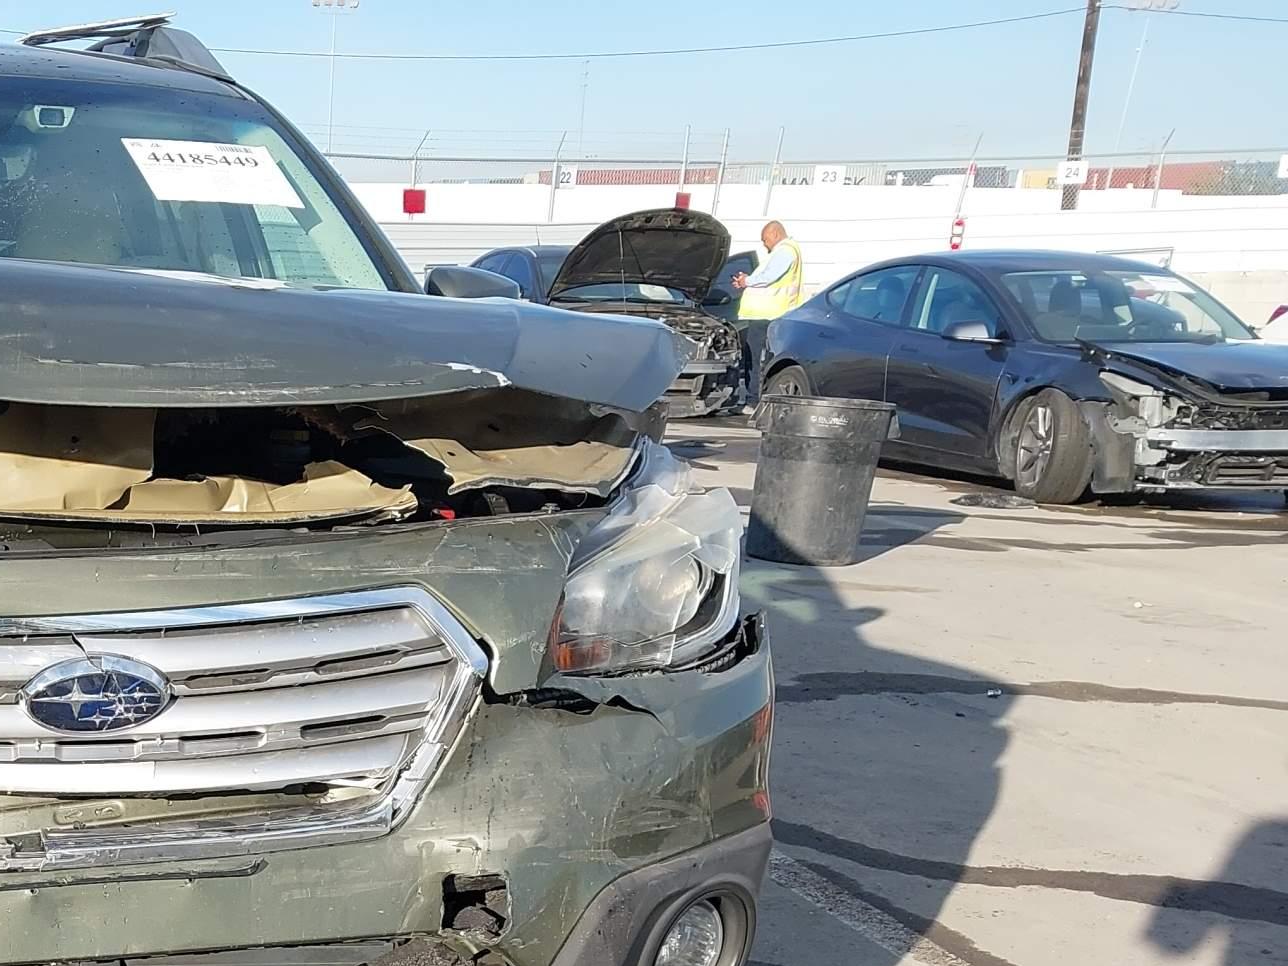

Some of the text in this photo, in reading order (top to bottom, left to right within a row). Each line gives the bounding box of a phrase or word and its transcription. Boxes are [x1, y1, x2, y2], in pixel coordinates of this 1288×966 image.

[147, 151, 259, 168] 44185449
[559, 171, 572, 184] 22
[822, 171, 838, 183] 23
[1065, 167, 1080, 178] 24
